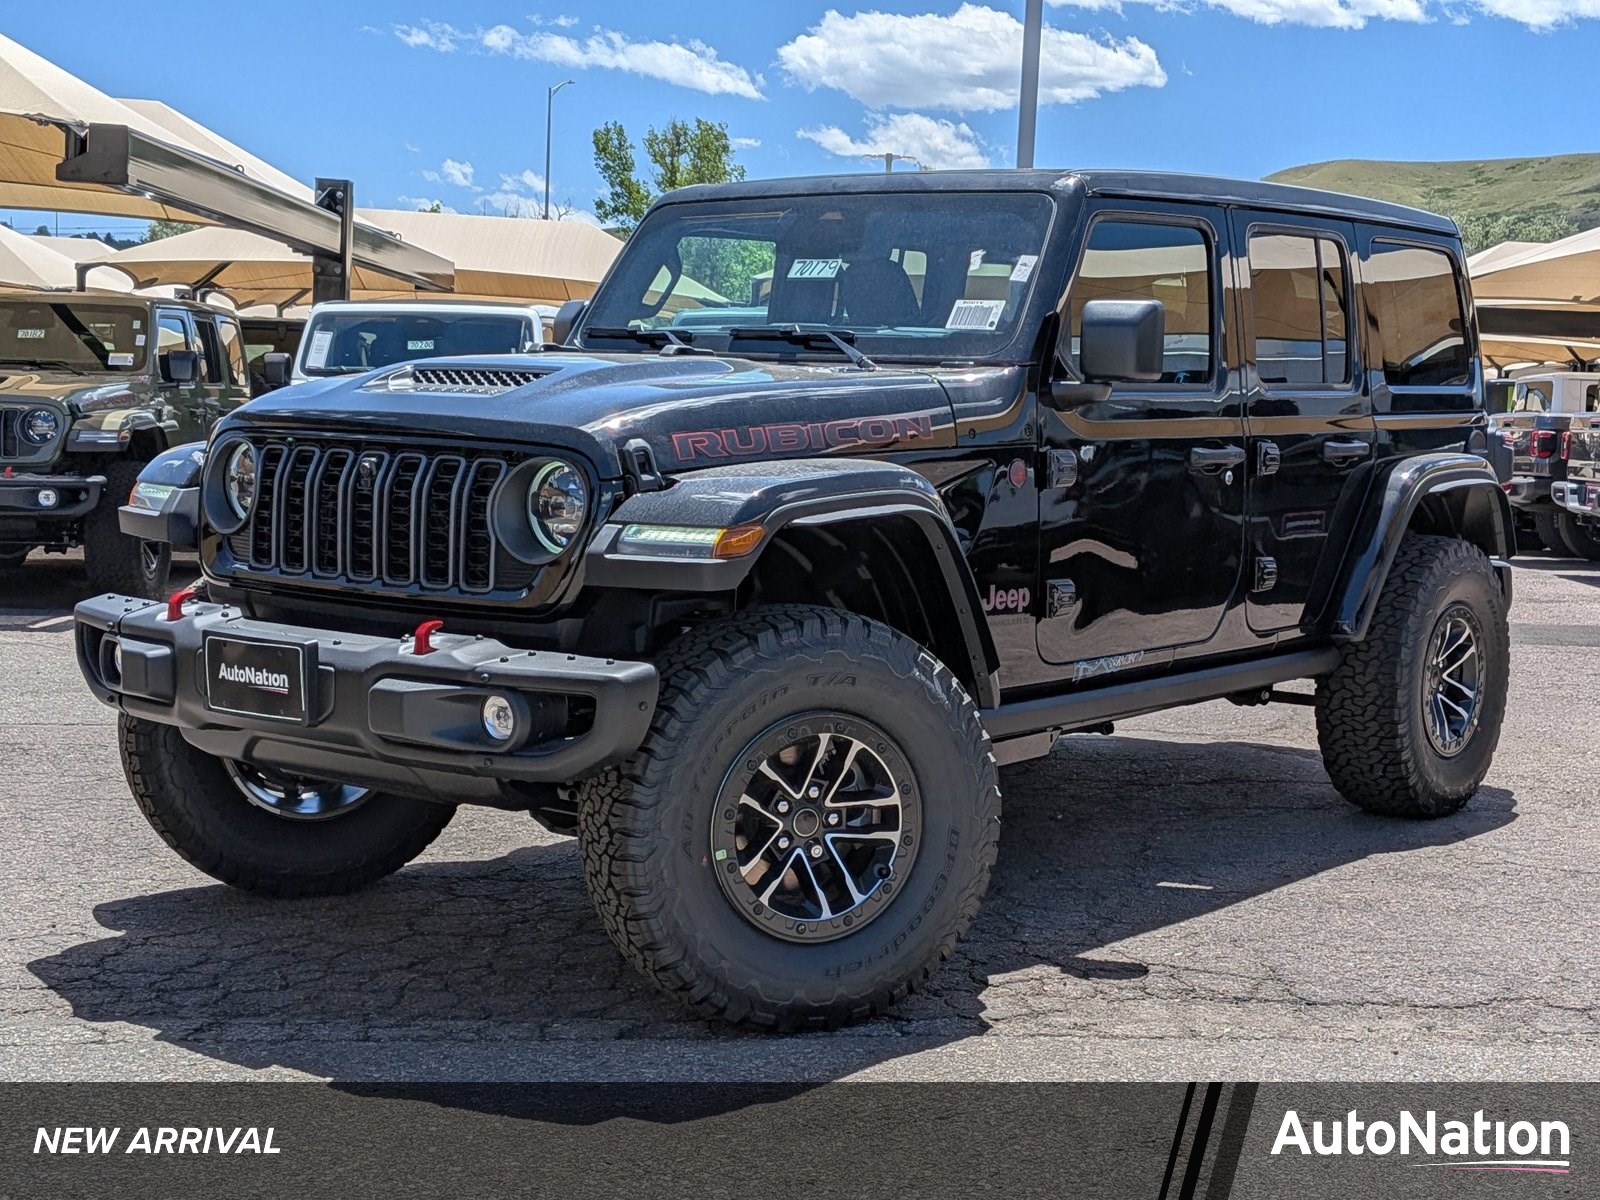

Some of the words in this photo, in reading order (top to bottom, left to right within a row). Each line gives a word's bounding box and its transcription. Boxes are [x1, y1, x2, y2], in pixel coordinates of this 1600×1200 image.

[795, 260, 839, 276] 70179
[671, 415, 934, 462] RUBICON
[982, 584, 1031, 613] Jeep
[218, 662, 289, 688] AutoNation
